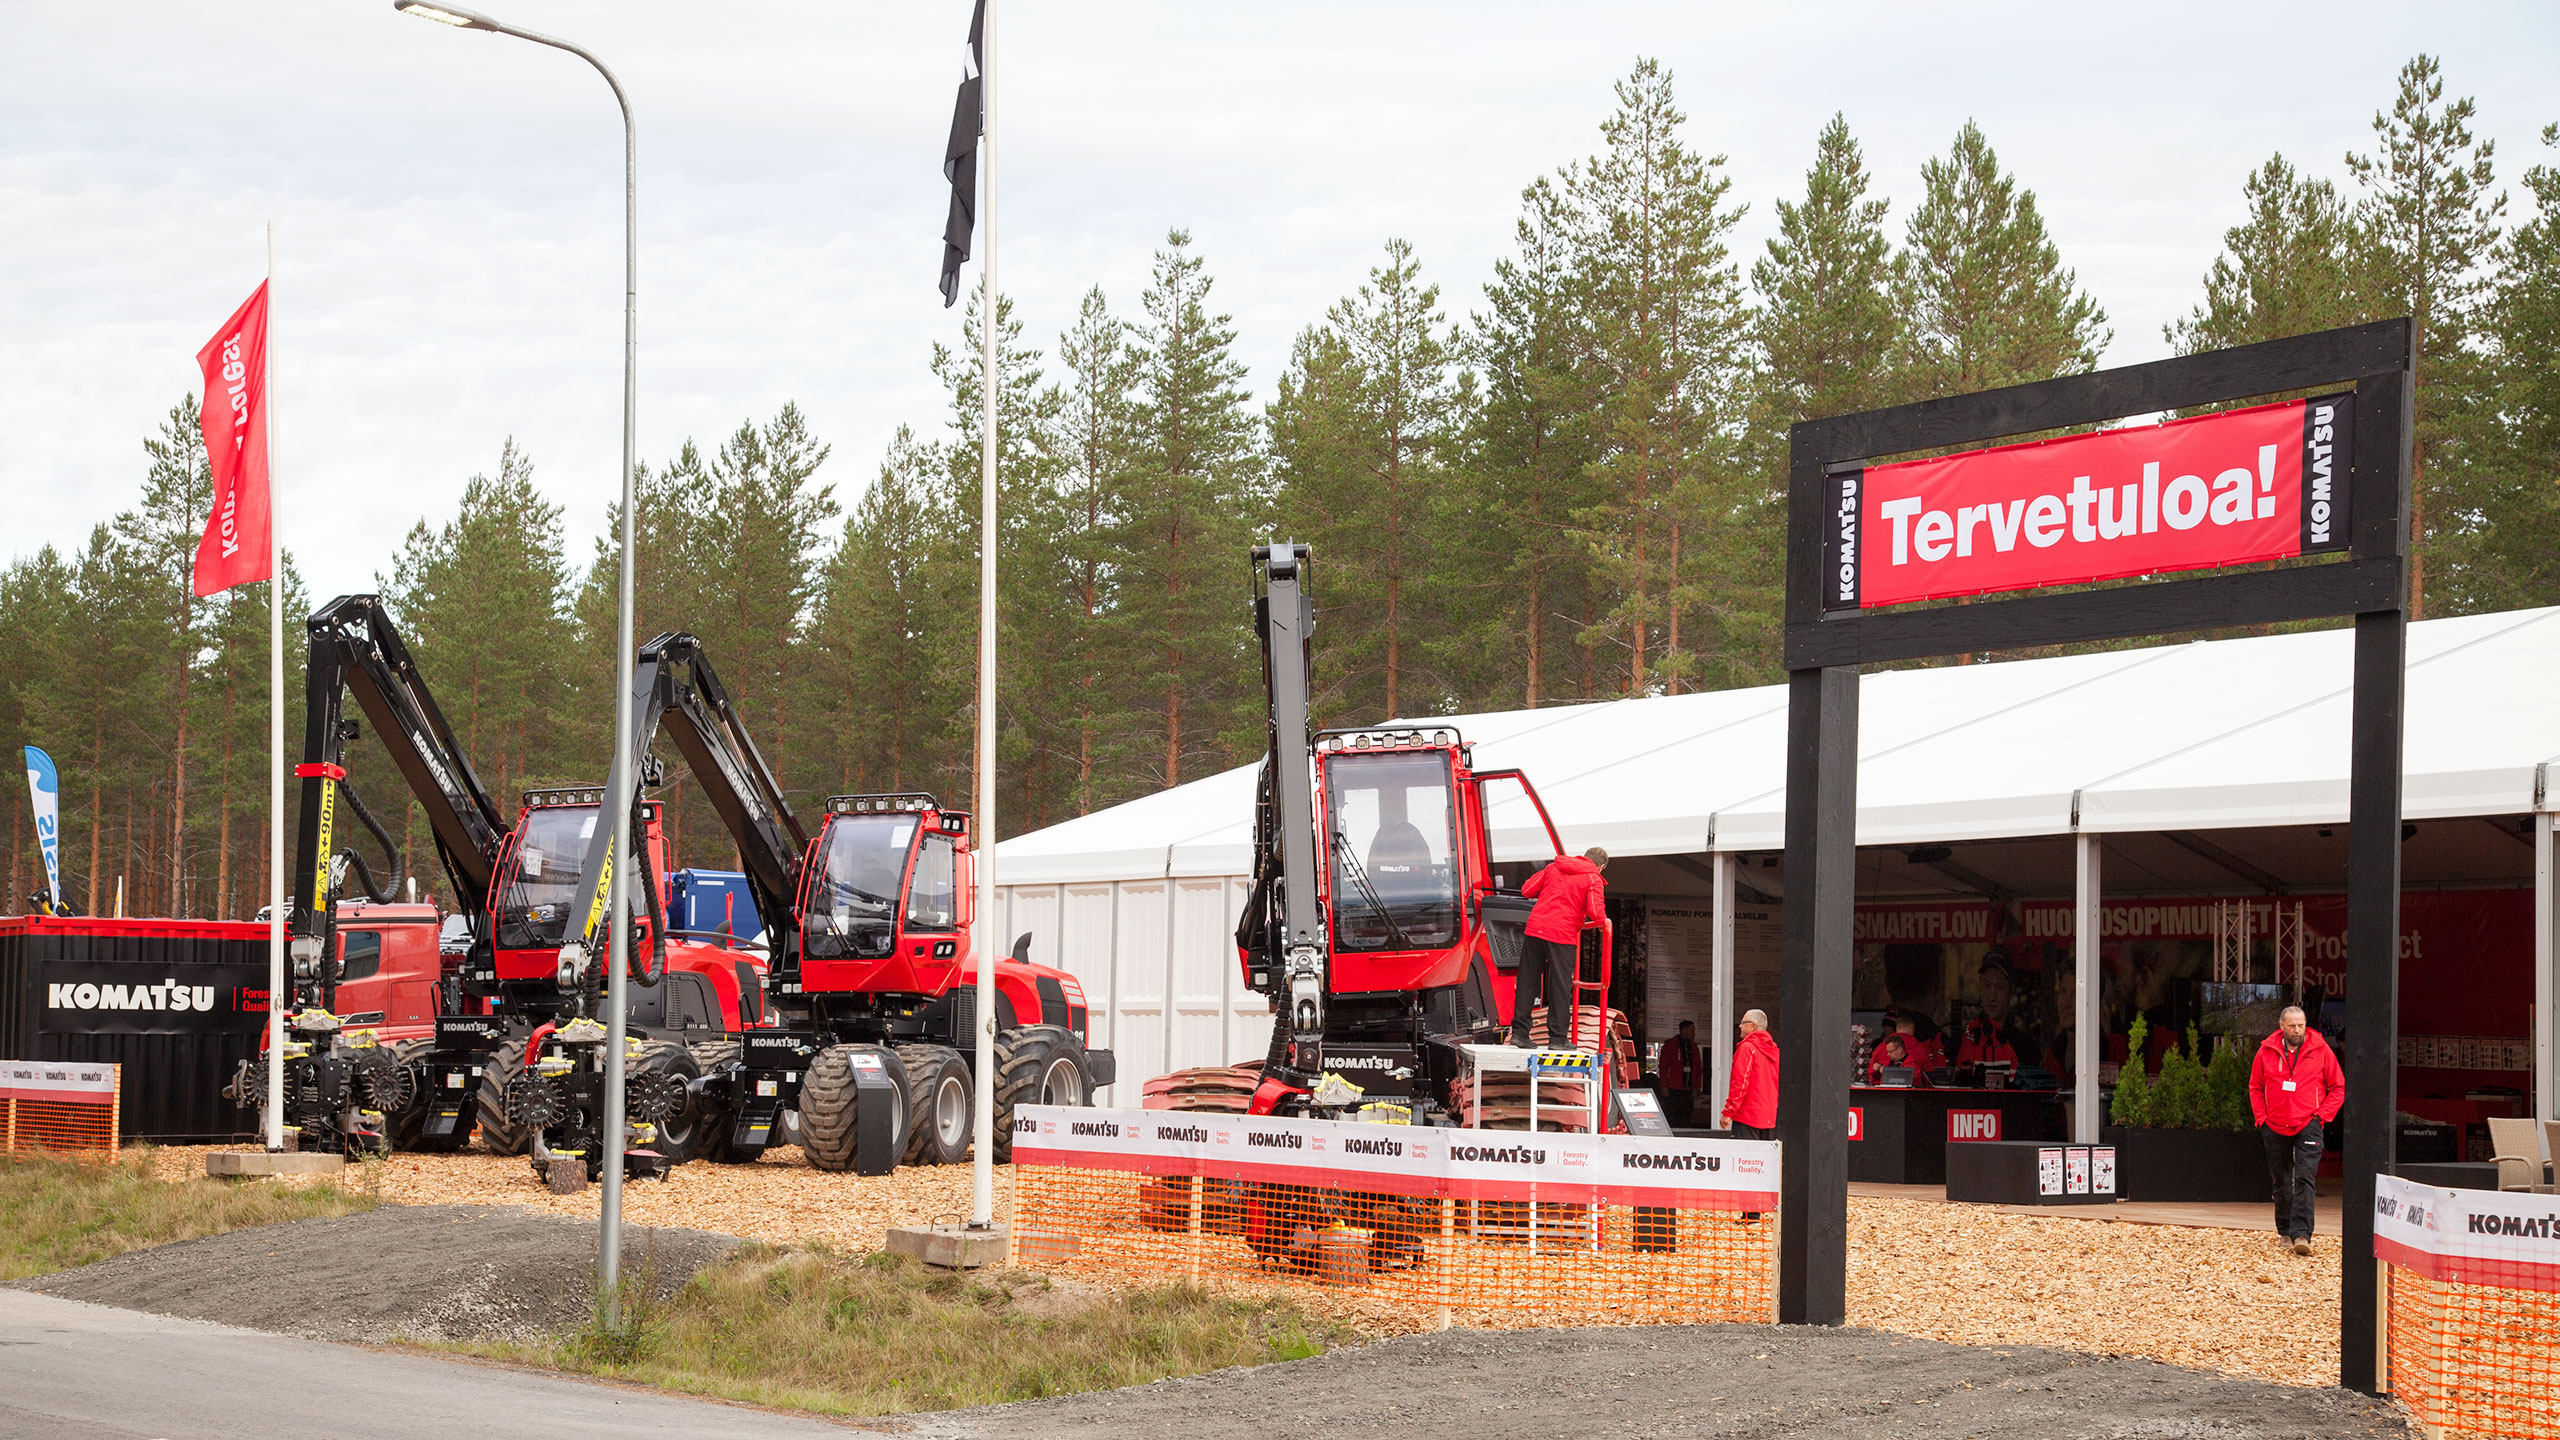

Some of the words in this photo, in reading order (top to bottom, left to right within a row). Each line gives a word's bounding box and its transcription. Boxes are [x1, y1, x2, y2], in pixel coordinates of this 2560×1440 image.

[2310, 404, 2335, 544] KOMATSU
[1880, 444, 2278, 567] Tervetuloa!
[1839, 479, 1857, 601] KOMATSU
[413, 730, 453, 793] KOMATSU
[727, 764, 760, 821] KOMATSU
[321, 794, 334, 836] 90m
[1651, 909, 1692, 918] KOMATSU
[1734, 912, 1769, 921] ALVELEE
[1853, 909, 1988, 940] SMARTFLOW
[48, 978, 215, 1012] KOMATSU
[242, 987, 270, 999] Fores
[242, 1000, 270, 1012] Quali
[443, 1021, 489, 1032] KOMATSU
[751, 1036, 801, 1047] KOMATSU
[1324, 1055, 1394, 1069] KOMATSU
[1071, 1120, 1119, 1138] KOMATSU
[1157, 1125, 1208, 1143] KOMATSU
[1953, 1113, 1996, 1139] INFO
[1248, 1130, 1302, 1149] KOMATSU
[1345, 1137, 1402, 1157] KOMATSU
[1450, 1145, 1546, 1165] KOMATSU
[1563, 1151, 1589, 1160] Forestry
[1623, 1152, 1721, 1172] KOMATSU
[1738, 1157, 1764, 1167] Forestry
[2468, 1213, 2560, 1240] KOMAT
